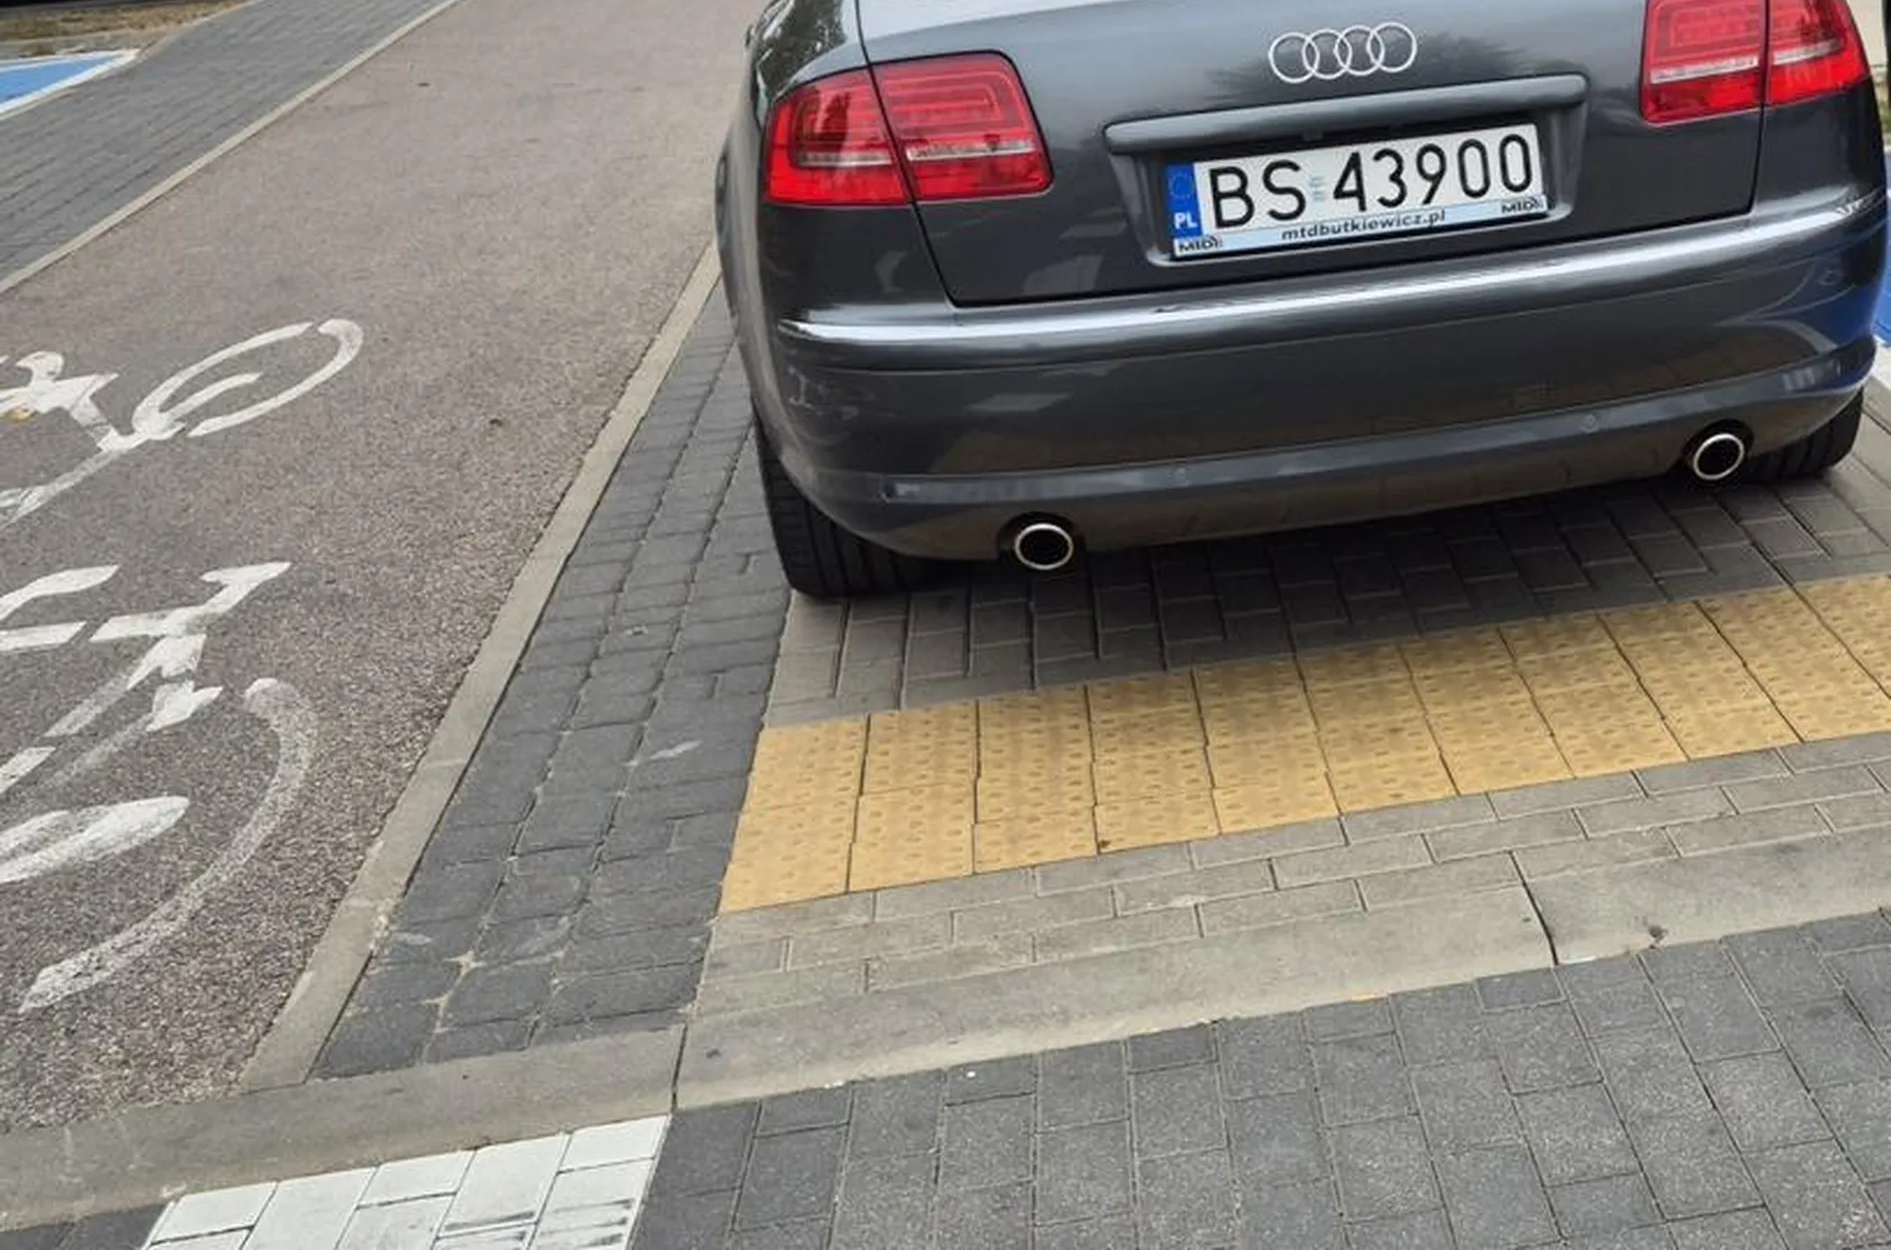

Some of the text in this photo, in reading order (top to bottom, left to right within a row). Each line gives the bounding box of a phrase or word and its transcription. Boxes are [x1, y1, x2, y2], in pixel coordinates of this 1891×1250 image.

[1209, 133, 1533, 230] BS 43900
[1174, 212, 1198, 229] PL
[1281, 209, 1446, 241] mtdbutkiewicz.pl
